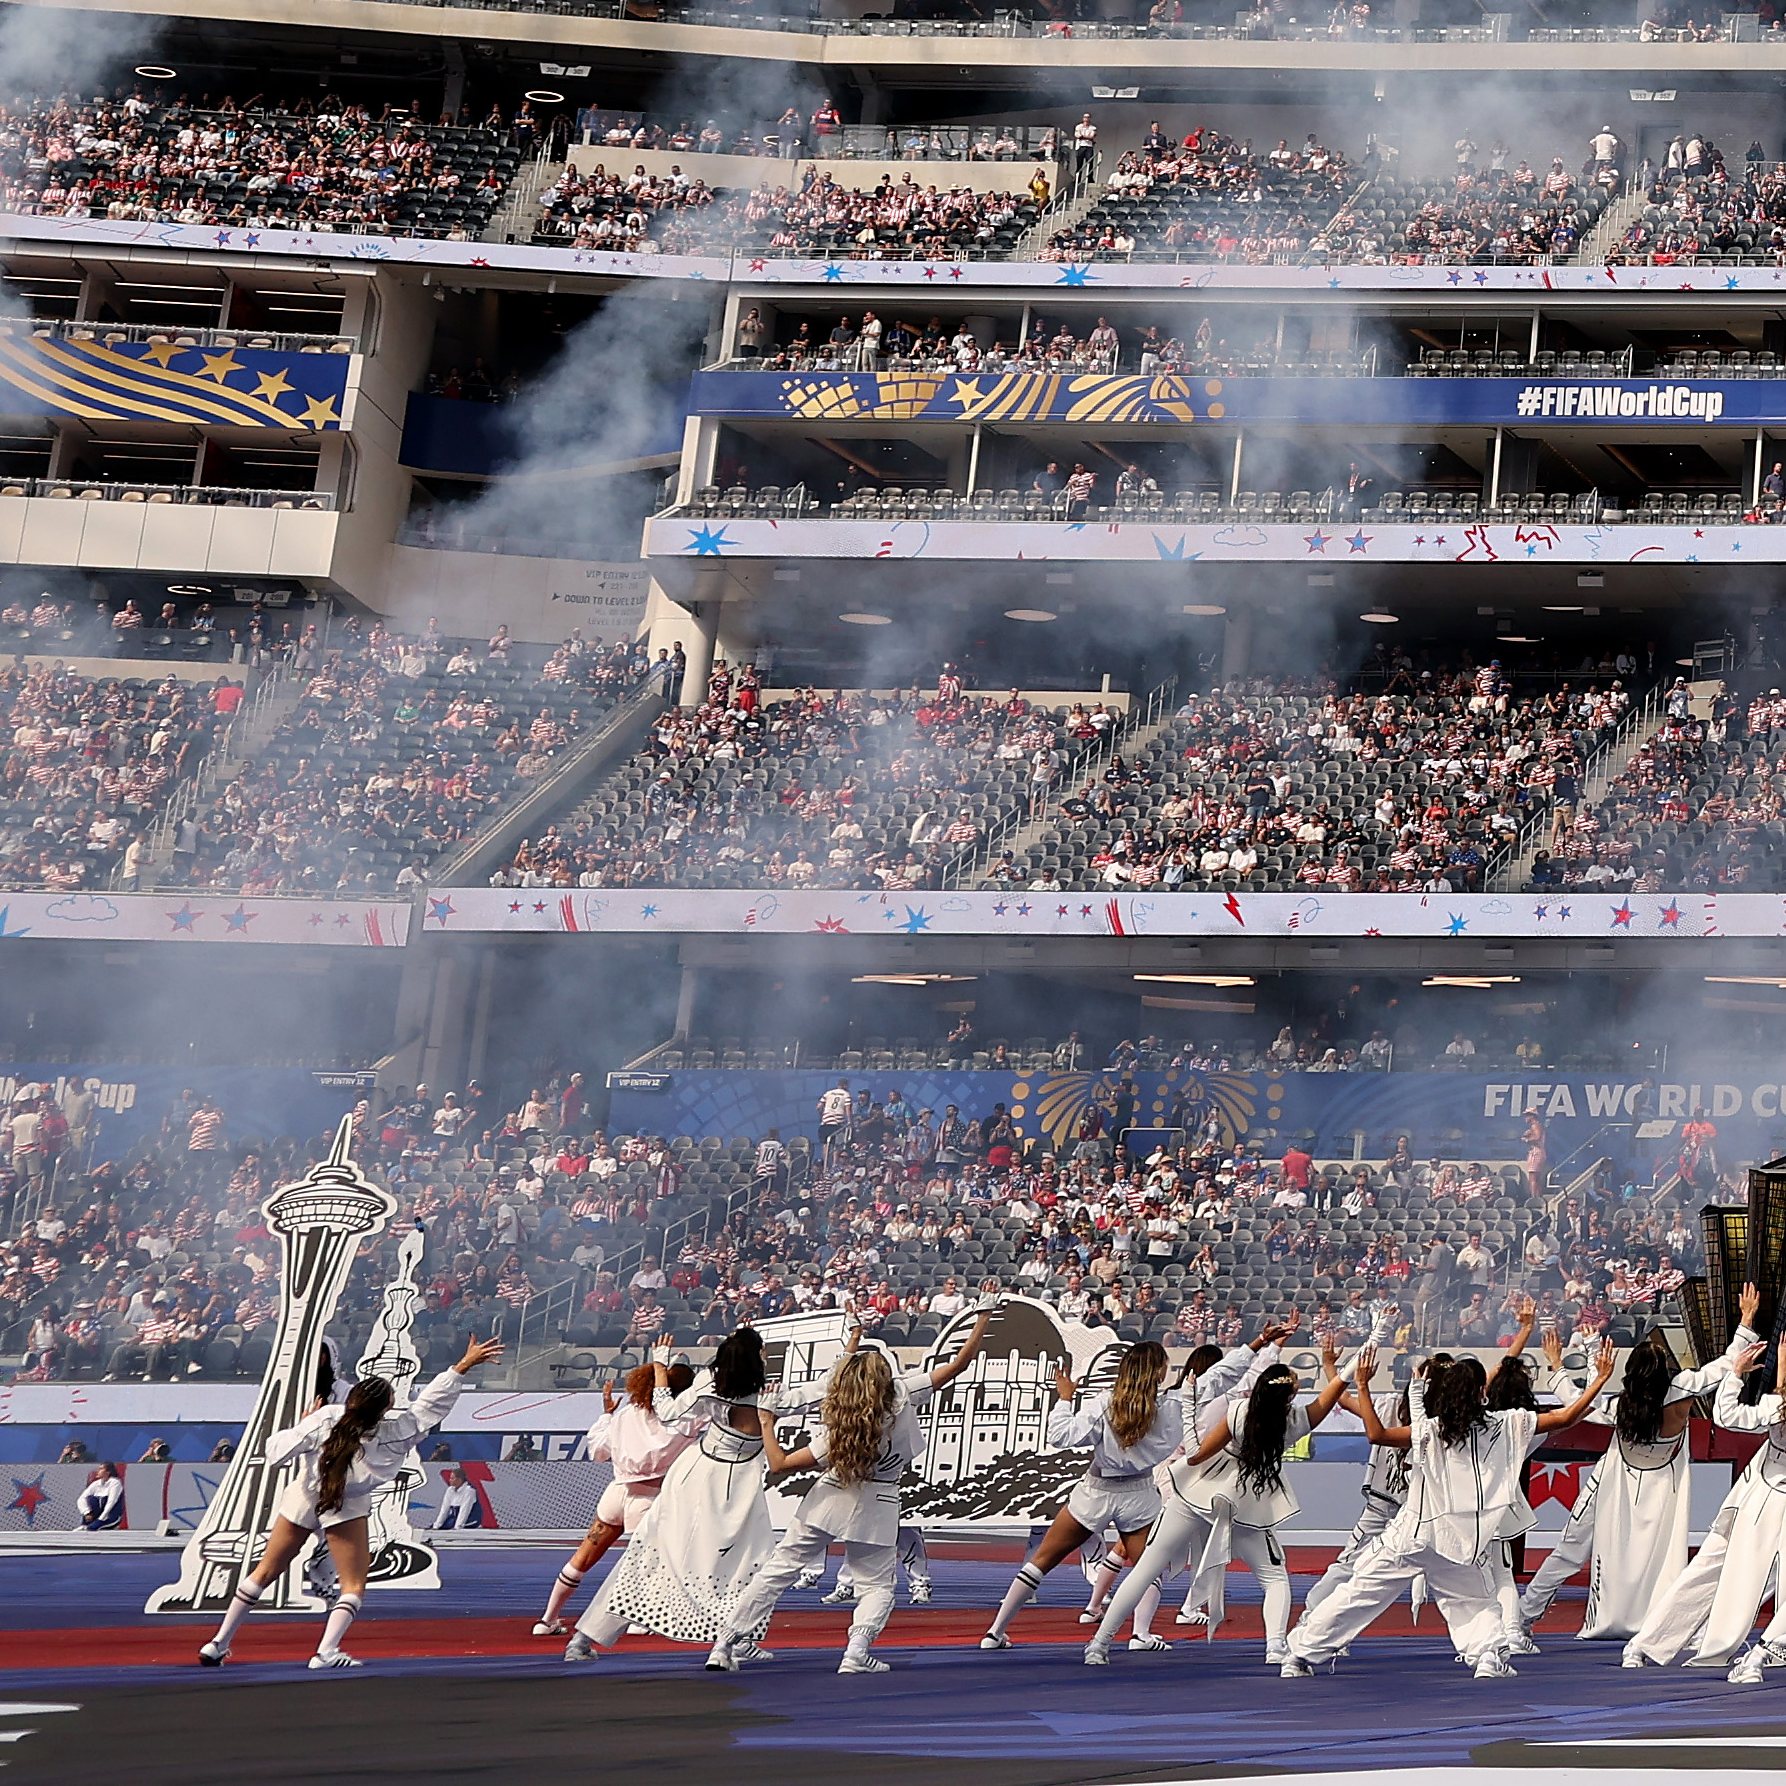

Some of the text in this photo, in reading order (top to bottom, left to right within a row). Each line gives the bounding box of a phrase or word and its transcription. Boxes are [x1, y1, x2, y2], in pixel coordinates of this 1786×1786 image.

[1516, 385, 1724, 422] #FIFAWorldCup
[586, 570, 601, 579] VIP
[564, 594, 590, 604] DOWN
[593, 596, 602, 605] TO
[605, 597, 628, 606] LEVEL
[619, 1078, 631, 1086] VIP
[631, 1078, 652, 1086] ENTRY
[831, 1096, 841, 1110] 8
[1484, 1083, 1577, 1118] FIFA
[762, 1147, 775, 1163] 10
